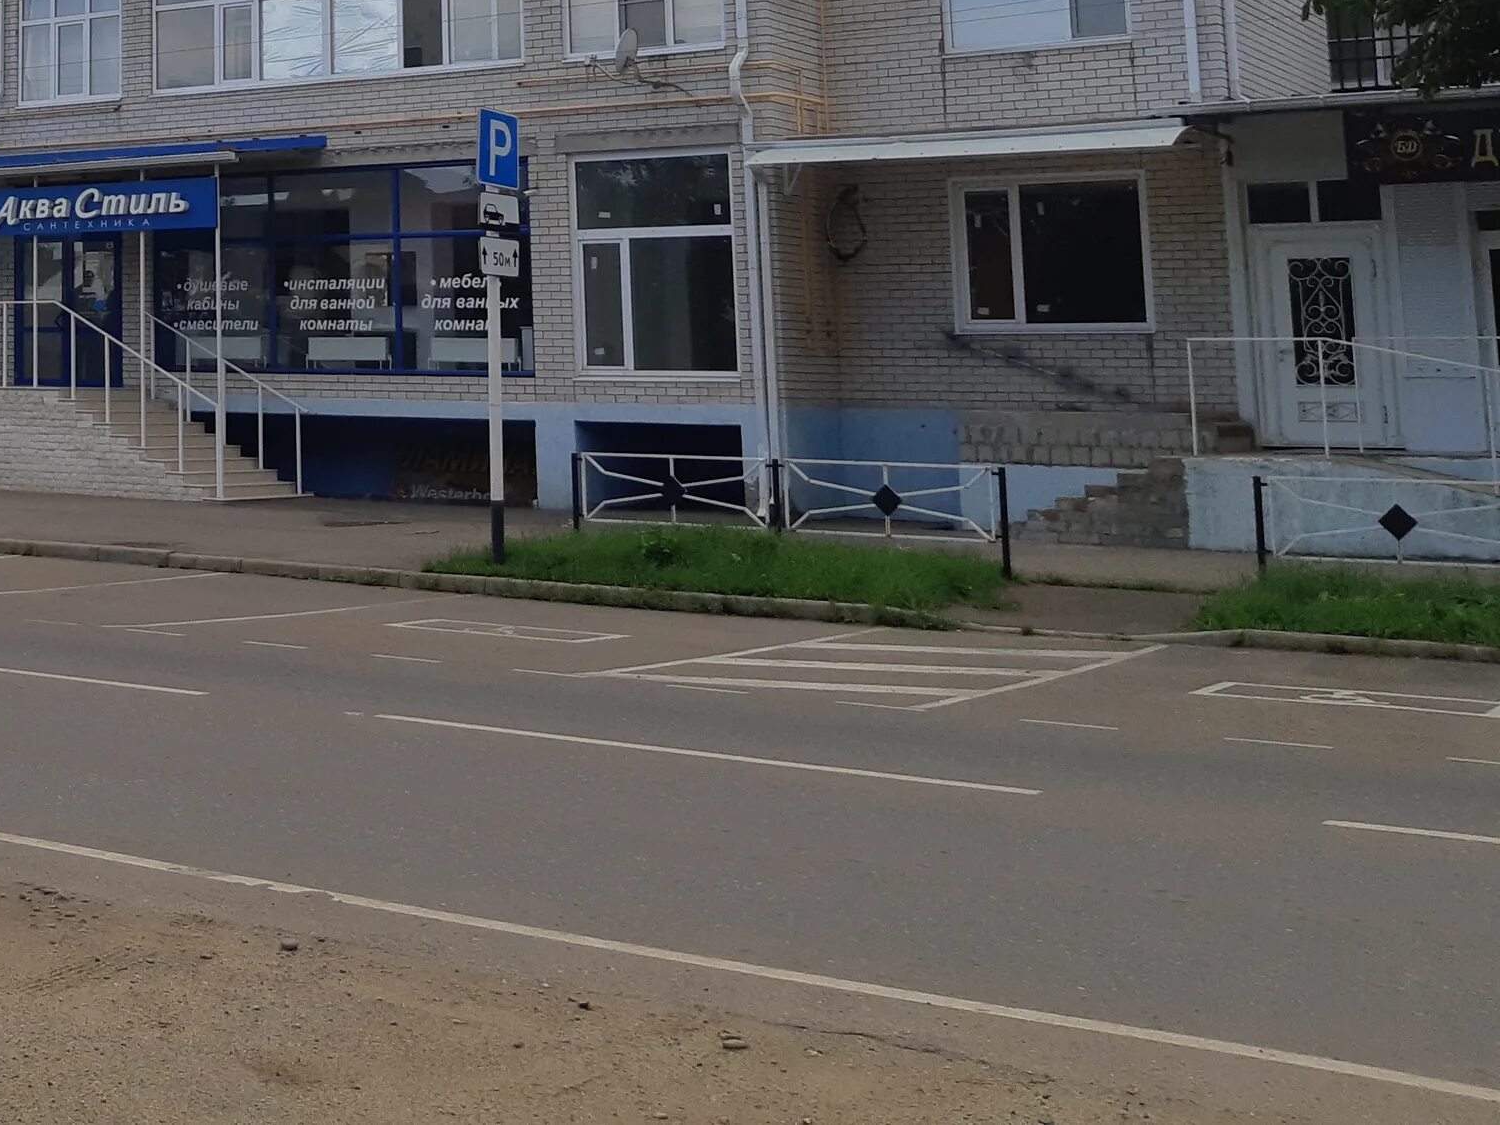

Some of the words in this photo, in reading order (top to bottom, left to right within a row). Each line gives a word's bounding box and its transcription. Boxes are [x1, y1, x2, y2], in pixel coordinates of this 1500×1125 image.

[489, 119, 512, 177] P
[75, 187, 190, 219] Стиль
[23, 218, 150, 231] САНТЕХНИКА
[288, 278, 386, 292] инсталяции
[439, 273, 502, 289] мебел
[290, 296, 317, 310] для
[320, 295, 376, 310] ванной
[421, 294, 451, 309] для
[299, 319, 373, 331] комнаты
[434, 319, 489, 331] комна
